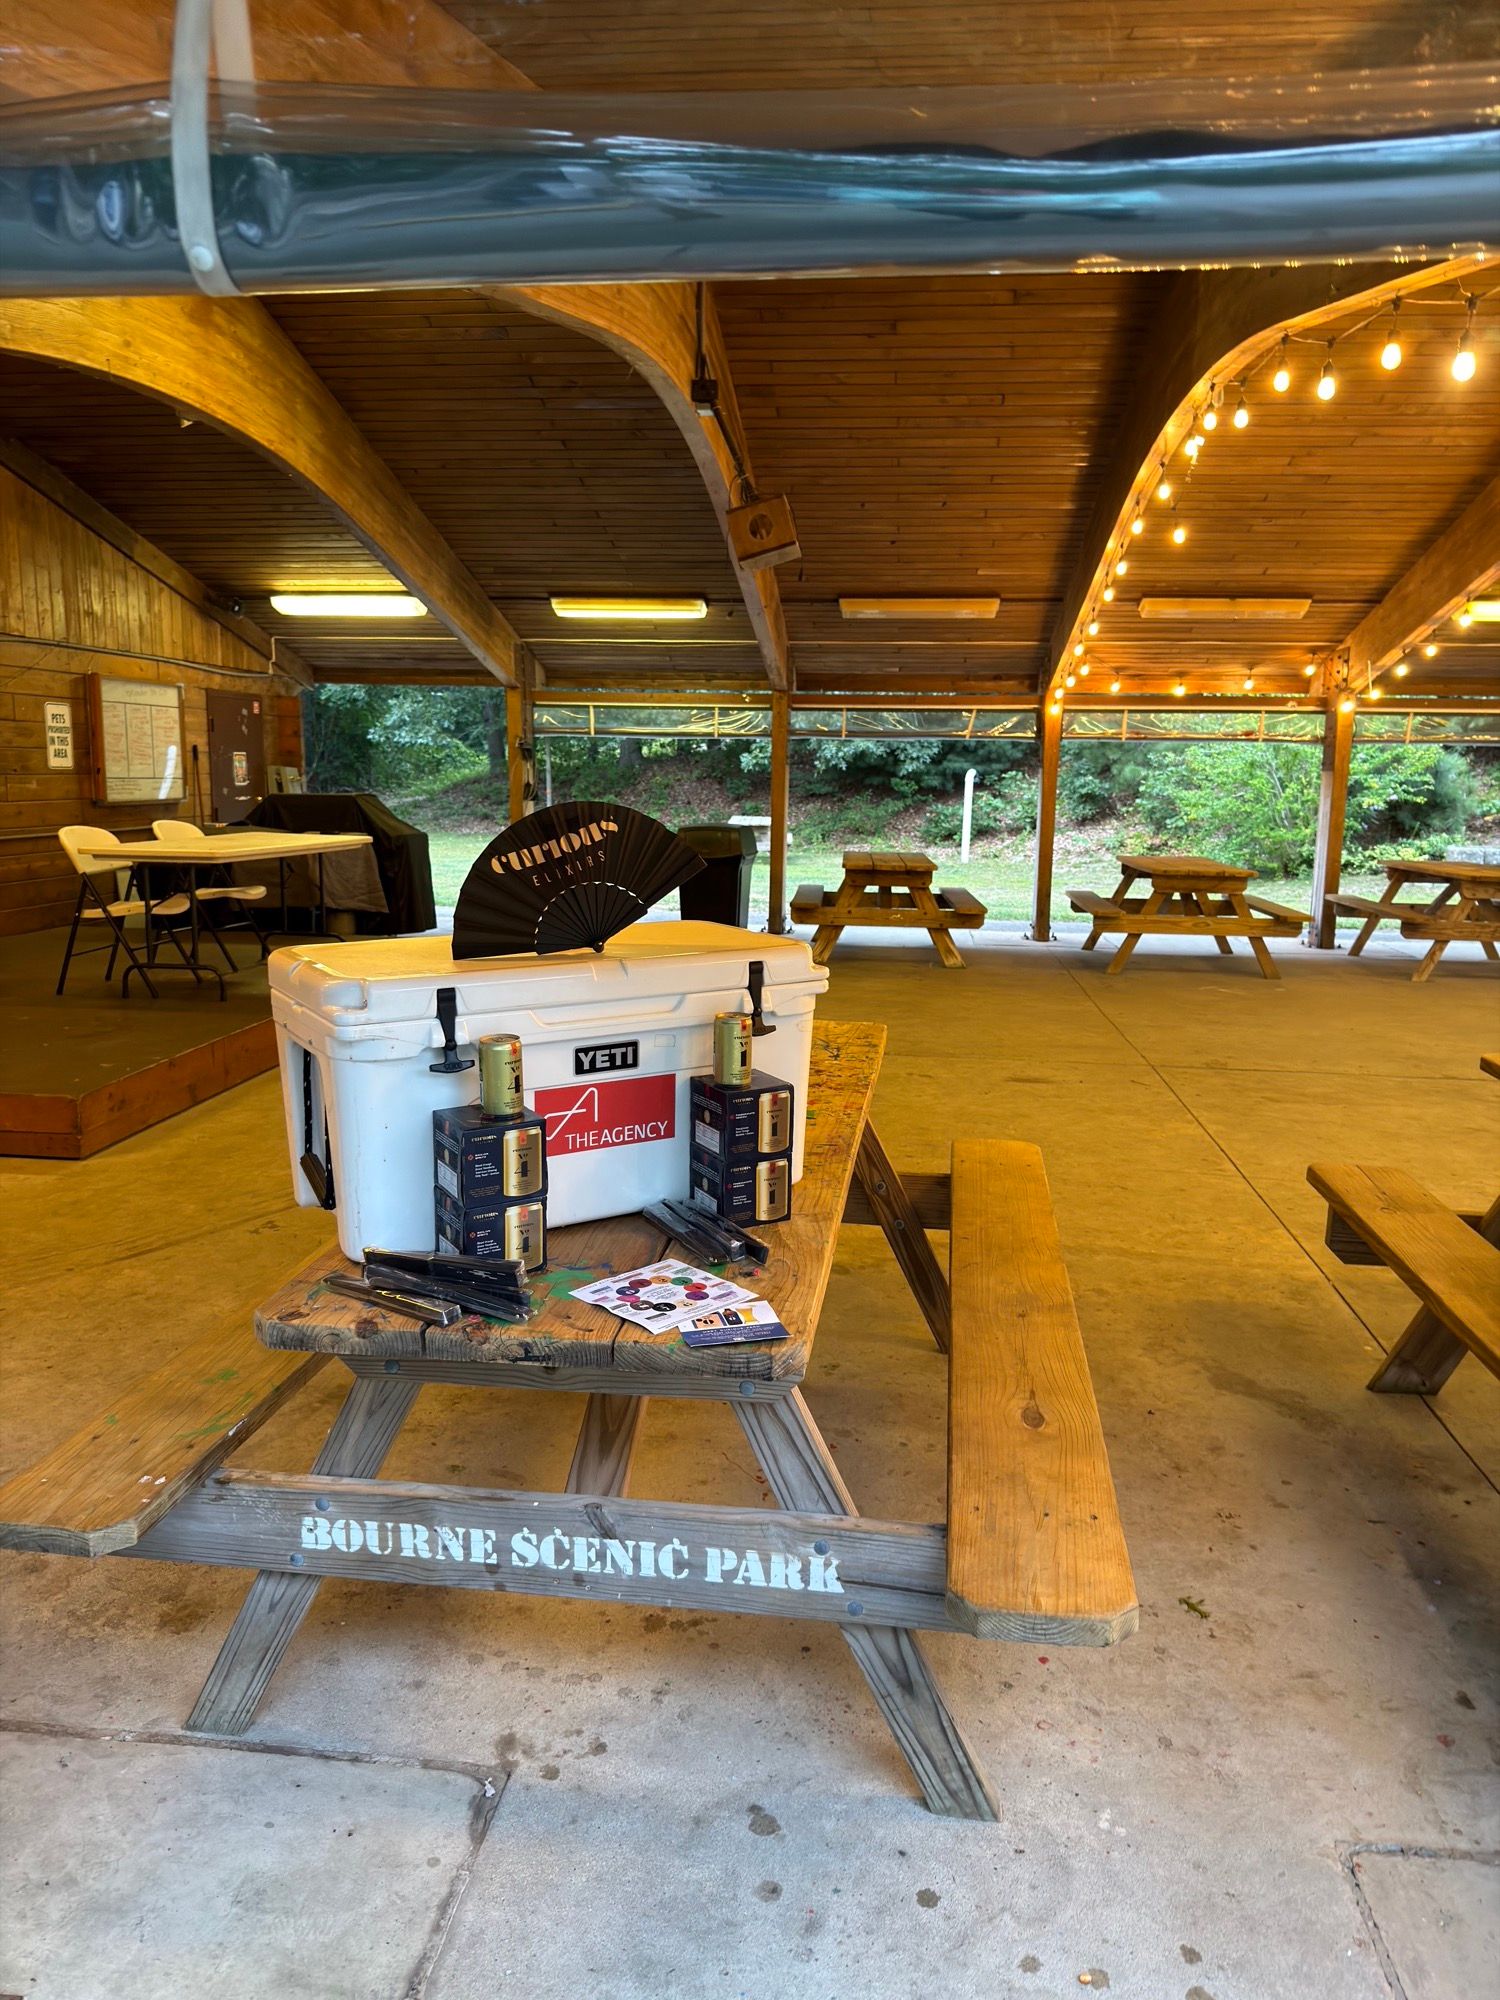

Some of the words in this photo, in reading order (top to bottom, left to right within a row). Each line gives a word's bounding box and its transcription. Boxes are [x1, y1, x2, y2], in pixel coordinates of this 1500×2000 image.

[51, 713, 66, 724] PETS
[49, 736, 56, 746] IN
[57, 736, 69, 747] THIS
[54, 748, 67, 758] AREA
[532, 850, 606, 887] ELIXIRS
[578, 1046, 635, 1071] YETI
[507, 1074, 522, 1094] 4
[514, 1161, 531, 1178] 4
[515, 1236, 532, 1253] 4
[301, 1516, 498, 1564] BOURNE
[511, 1527, 690, 1580] SCENIC
[704, 1547, 845, 1594] PARK
